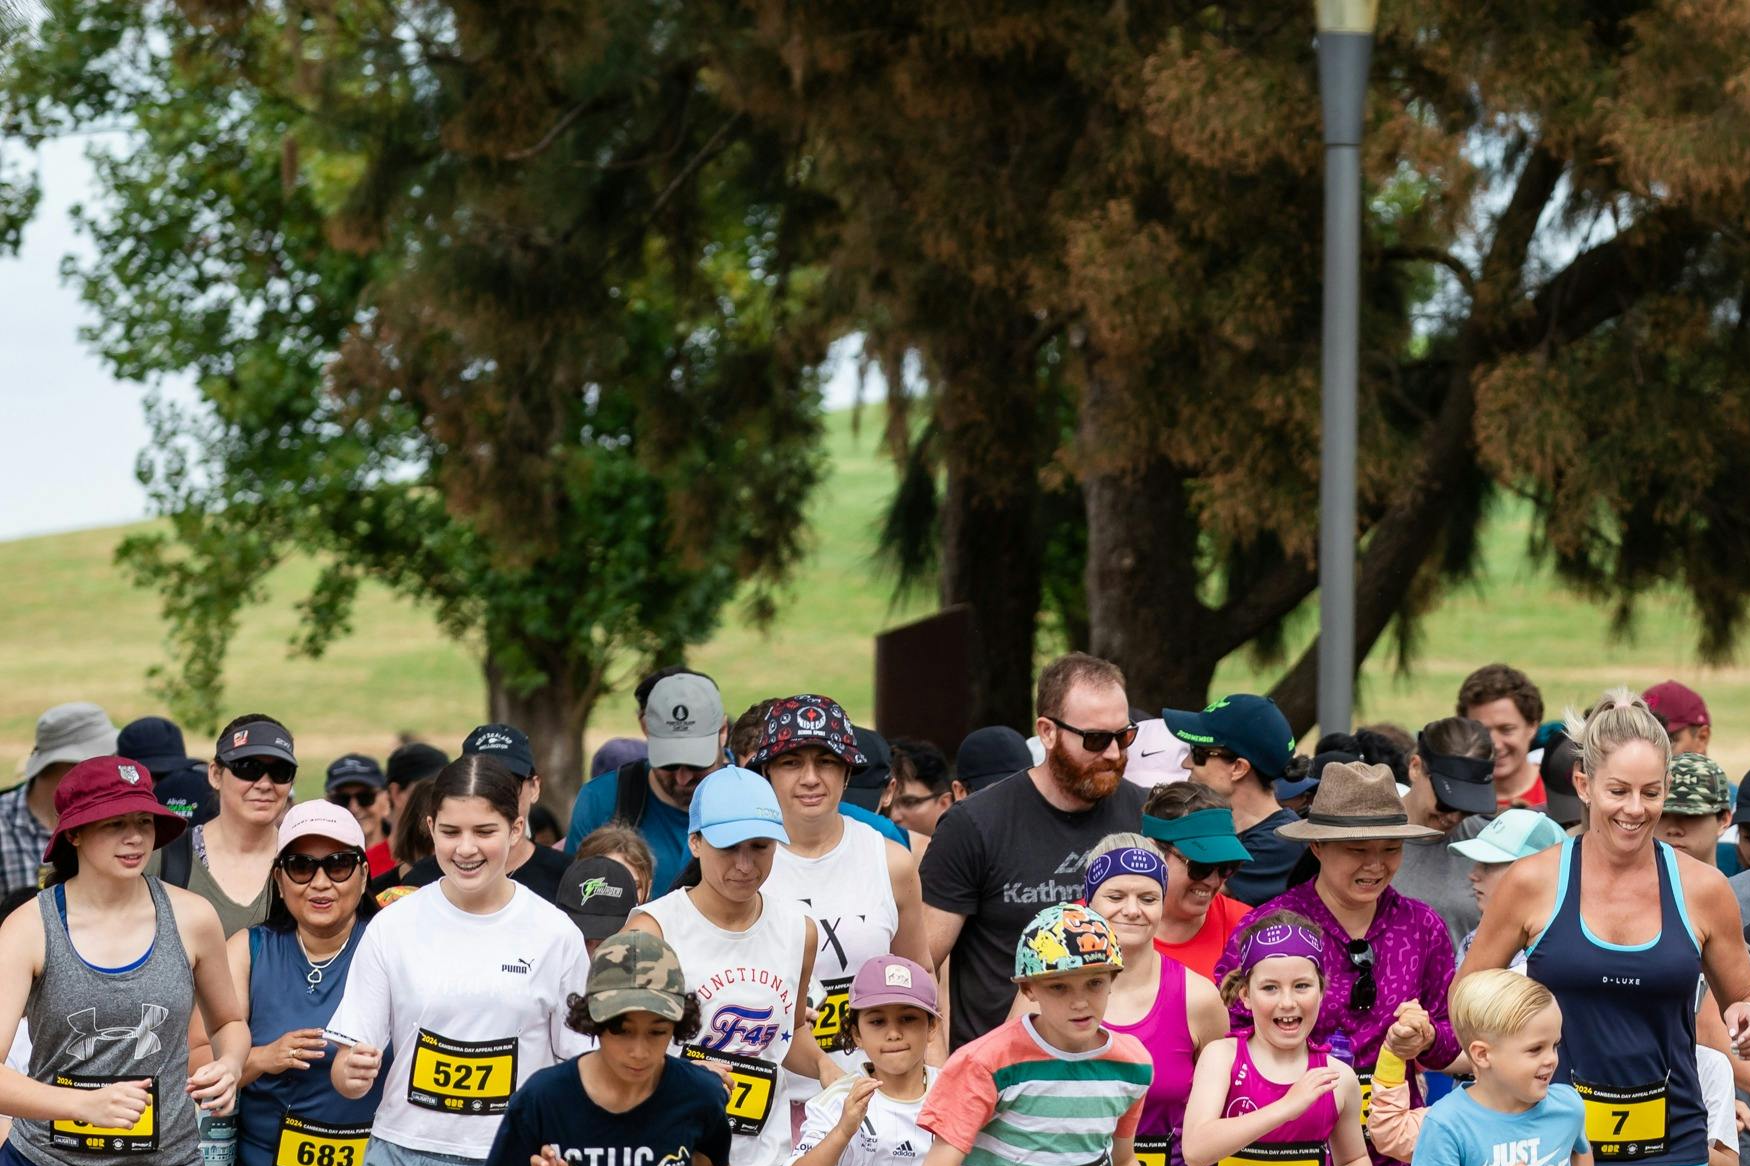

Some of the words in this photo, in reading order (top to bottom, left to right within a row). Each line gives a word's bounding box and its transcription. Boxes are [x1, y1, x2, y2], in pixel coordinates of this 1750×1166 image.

[501, 964, 527, 974] PUMA
[697, 967, 794, 1015] UNCTIONAL
[421, 1033, 438, 1047] 2024
[438, 1042, 464, 1053] CANBERRA
[686, 1049, 705, 1061] 2024
[705, 1055, 731, 1066] CANBERRA
[730, 1060, 741, 1068] DAY
[740, 1063, 756, 1071] APPEAL
[56, 1076, 74, 1087] 2024
[73, 1081, 101, 1089] CANBERRA
[432, 1060, 494, 1091] 527
[734, 1081, 753, 1110] 7
[1574, 1084, 1593, 1095] 2024
[1593, 1090, 1621, 1099] CANBERRA
[1631, 1090, 1649, 1098] APPEAL
[285, 1117, 303, 1128] 2024
[303, 1124, 329, 1133] CANBERRA
[1611, 1111, 1630, 1136] 7
[892, 1149, 916, 1158] adidas
[1240, 1147, 1269, 1155] CANBERRA
